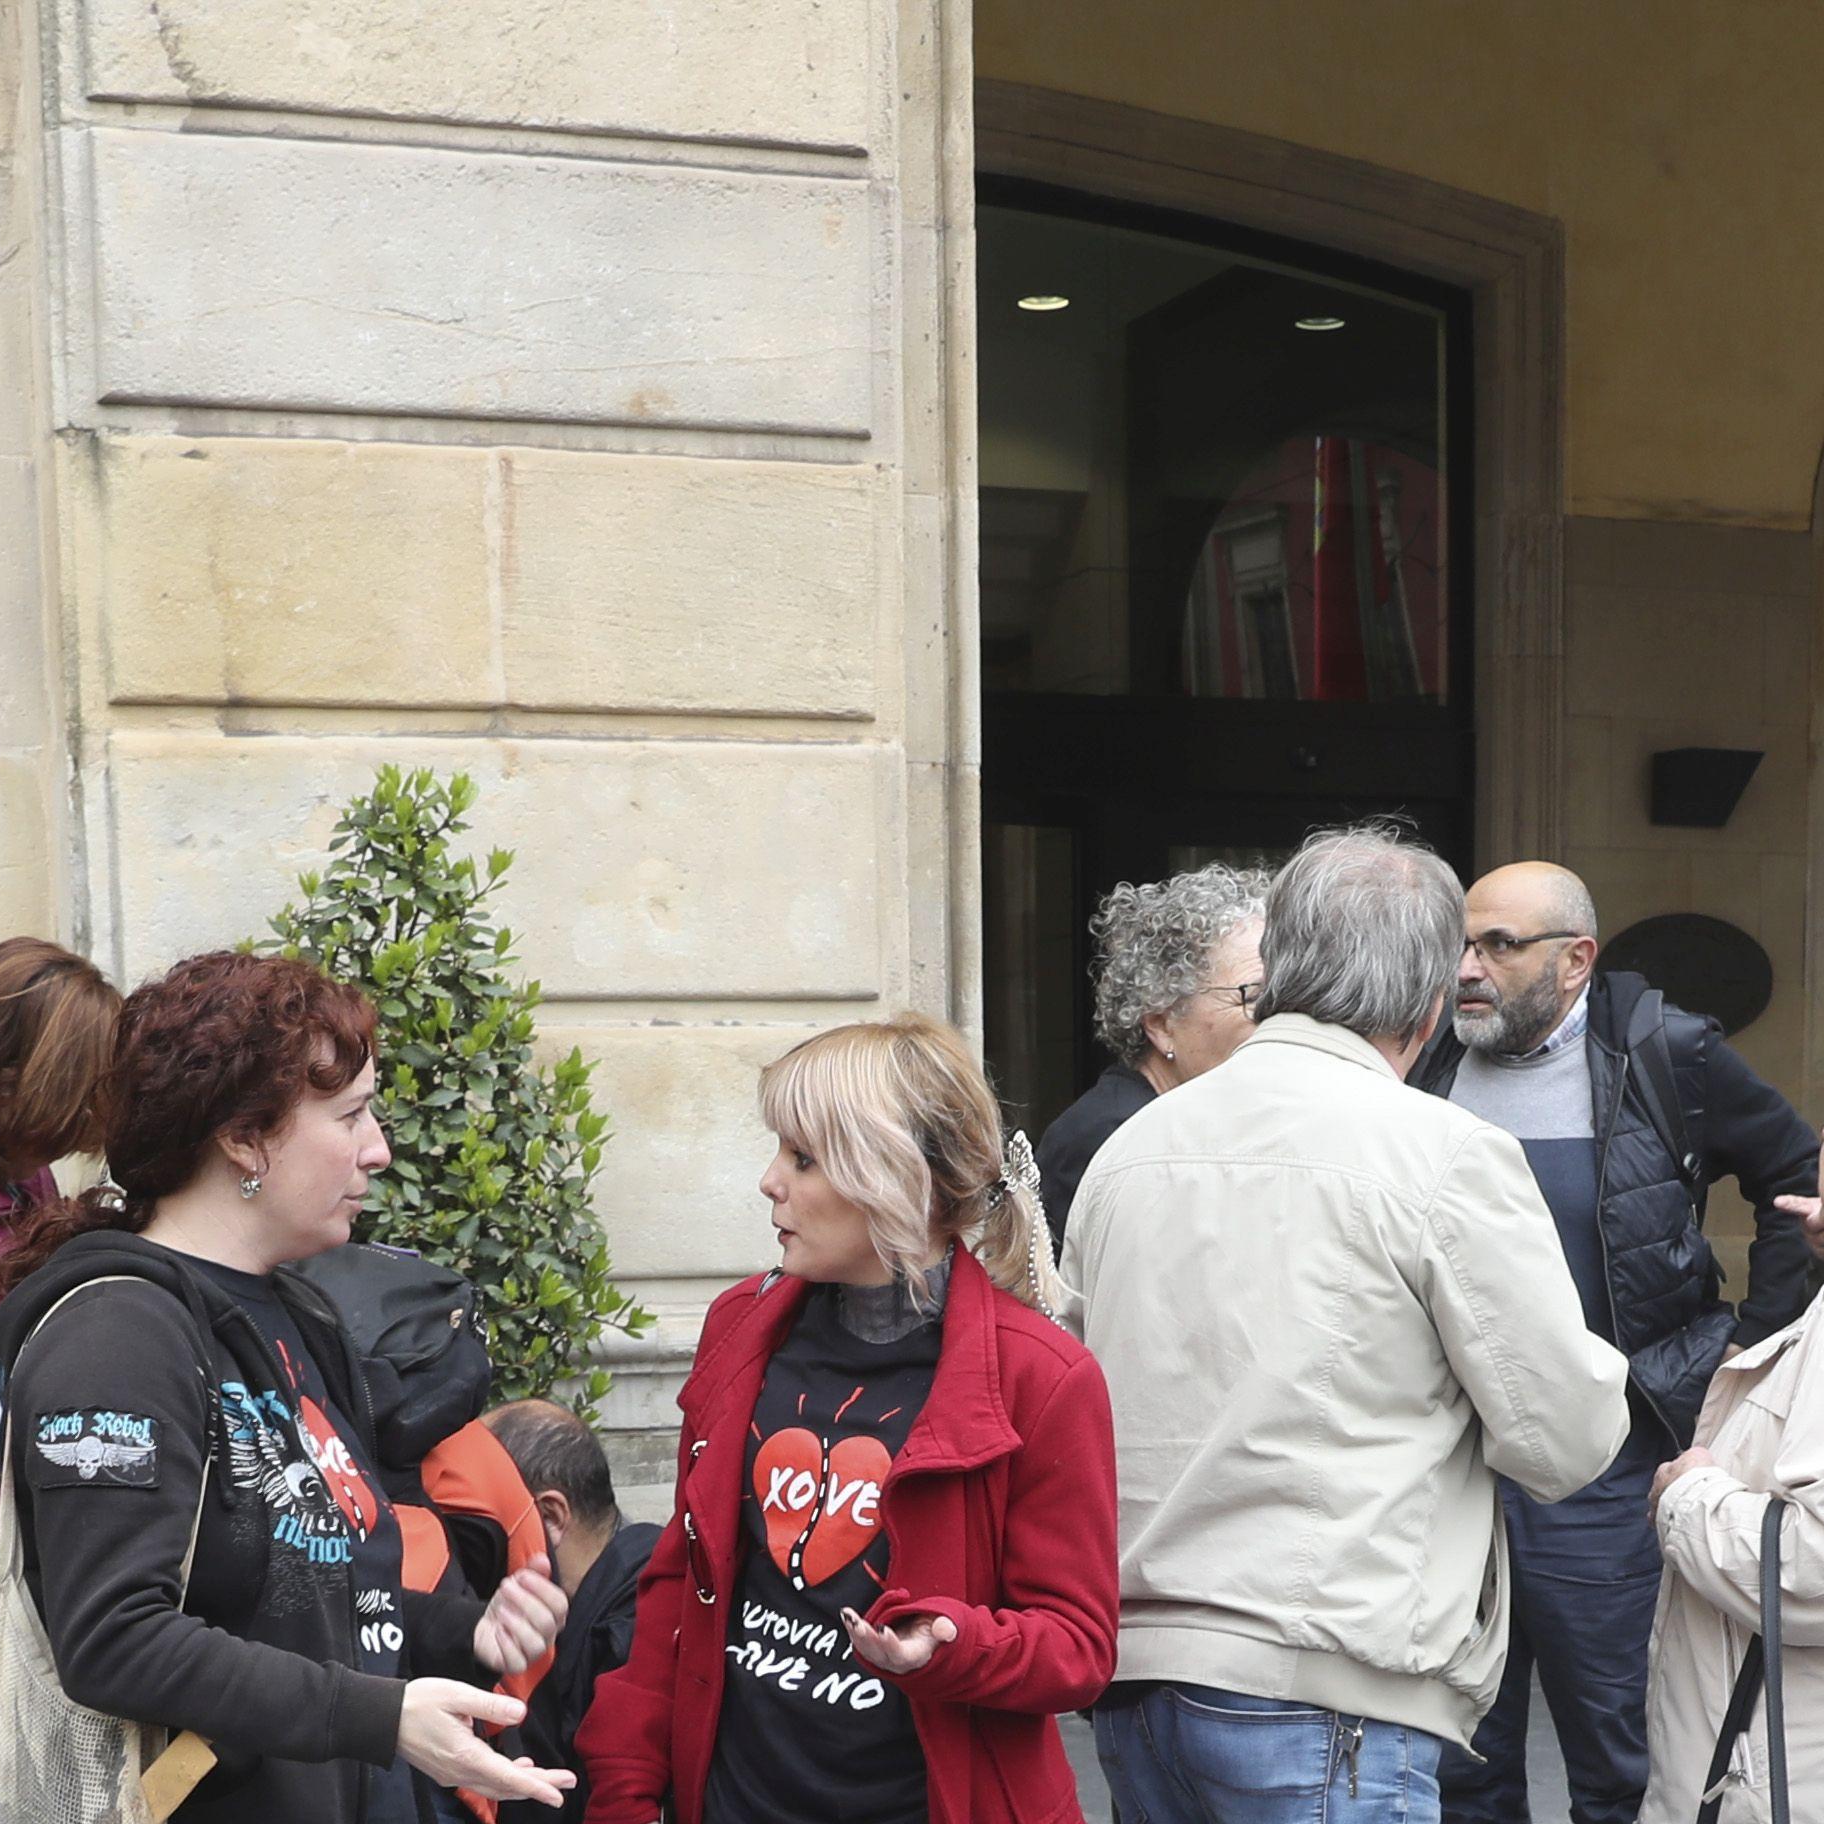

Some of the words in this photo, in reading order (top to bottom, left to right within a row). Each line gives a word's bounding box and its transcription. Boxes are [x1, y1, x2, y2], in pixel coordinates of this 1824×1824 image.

[763, 1467, 882, 1526] XOVE
[360, 1622, 404, 1654] NO
[812, 1672, 886, 1711] NO
